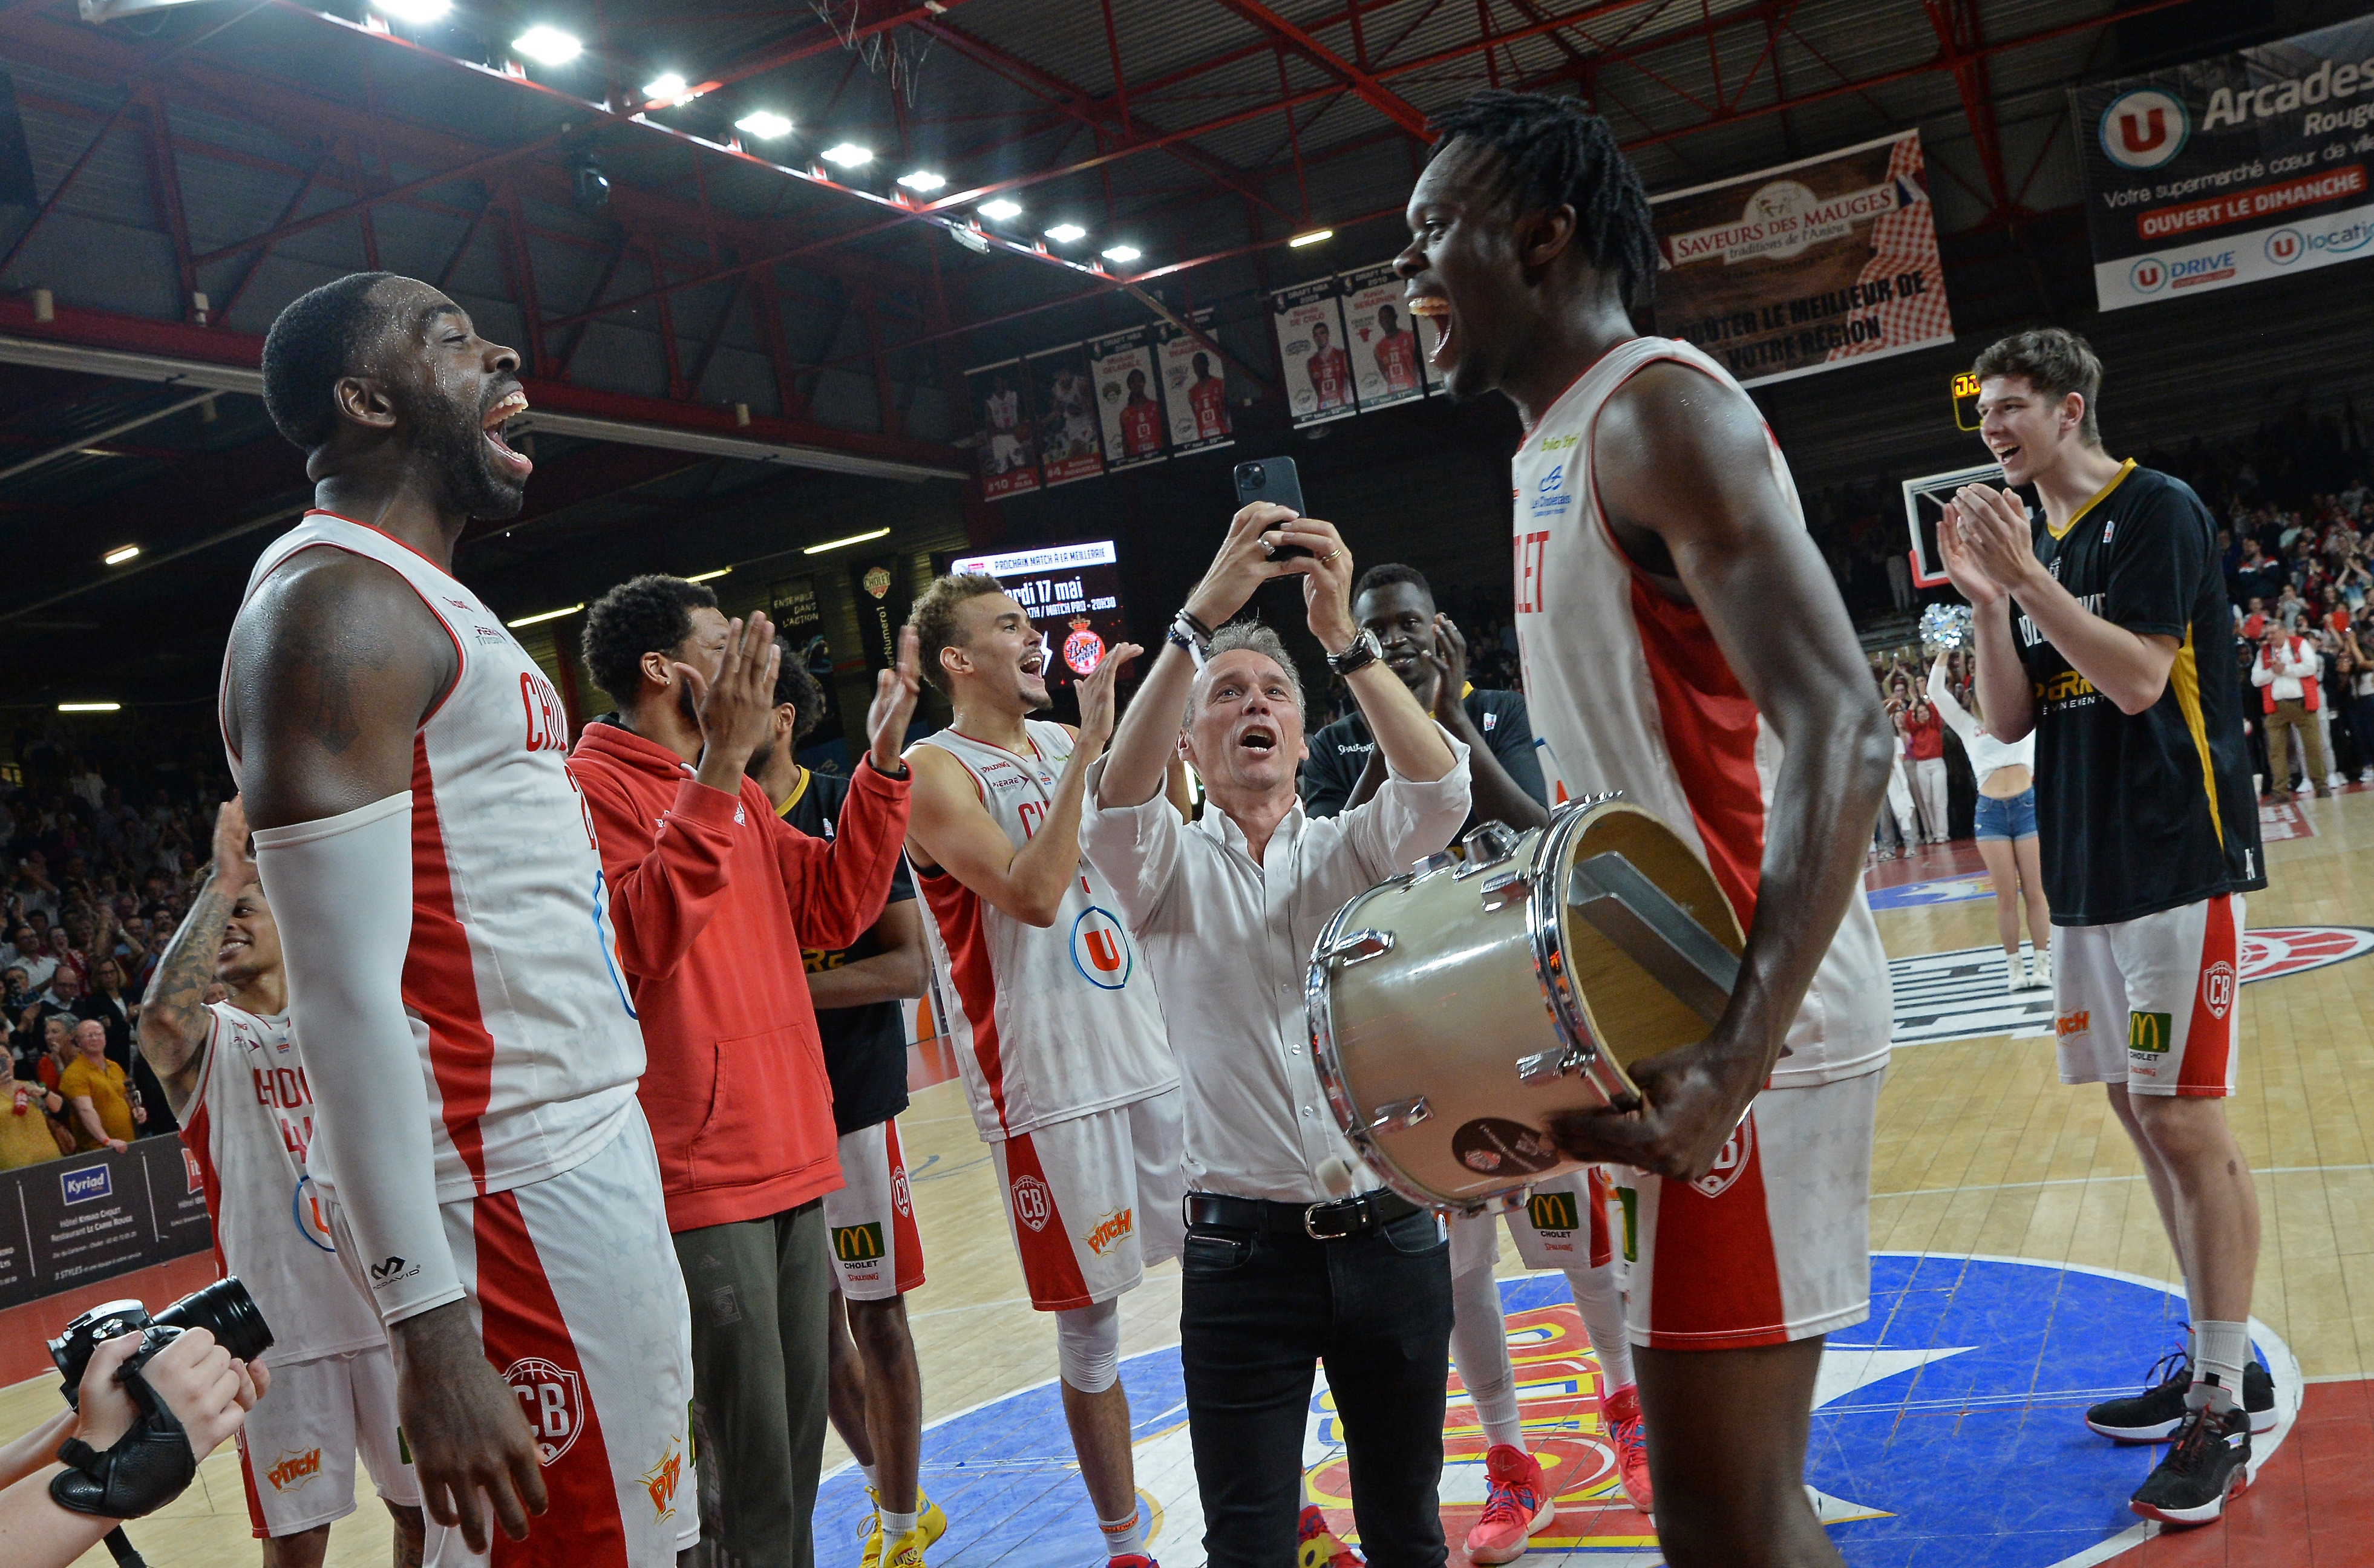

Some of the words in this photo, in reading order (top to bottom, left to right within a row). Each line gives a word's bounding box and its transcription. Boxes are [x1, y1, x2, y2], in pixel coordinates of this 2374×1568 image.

[2202, 57, 2374, 131] Arcades
[2121, 108, 2167, 153] U
[2104, 187, 2151, 209] Votre
[2156, 161, 2264, 199] supermarché
[2322, 143, 2346, 161] de
[2143, 206, 2223, 235] OUVERT
[2226, 199, 2251, 218] LE
[2255, 171, 2361, 213] DIMANCHE
[1679, 224, 1765, 258] SAVEURS
[1768, 217, 1797, 236] DES
[1805, 188, 1891, 227] MAUGES
[2171, 250, 2236, 278] DRIVE
[1763, 305, 1785, 328] LE
[1789, 278, 1892, 322] MEILLEUR
[1897, 270, 1926, 297] DE
[995, 558, 1028, 570] PROCHAIN
[1030, 555, 1052, 567] MATCH
[1060, 553, 1068, 563] LA
[1036, 579, 1051, 604] 17
[1055, 575, 1084, 600] mai
[1045, 601, 1071, 616] MATCH
[1071, 599, 1087, 613] PRO
[992, 777, 1019, 788] PIERRE
[1084, 929, 1120, 972] U
[2209, 975, 2231, 1005] CB
[67, 1172, 105, 1195] Kyriad
[895, 1178, 909, 1206] CB
[1018, 1189, 1045, 1218] CB
[844, 1260, 878, 1269] CHOLET
[848, 1273, 879, 1282] SPALDING
